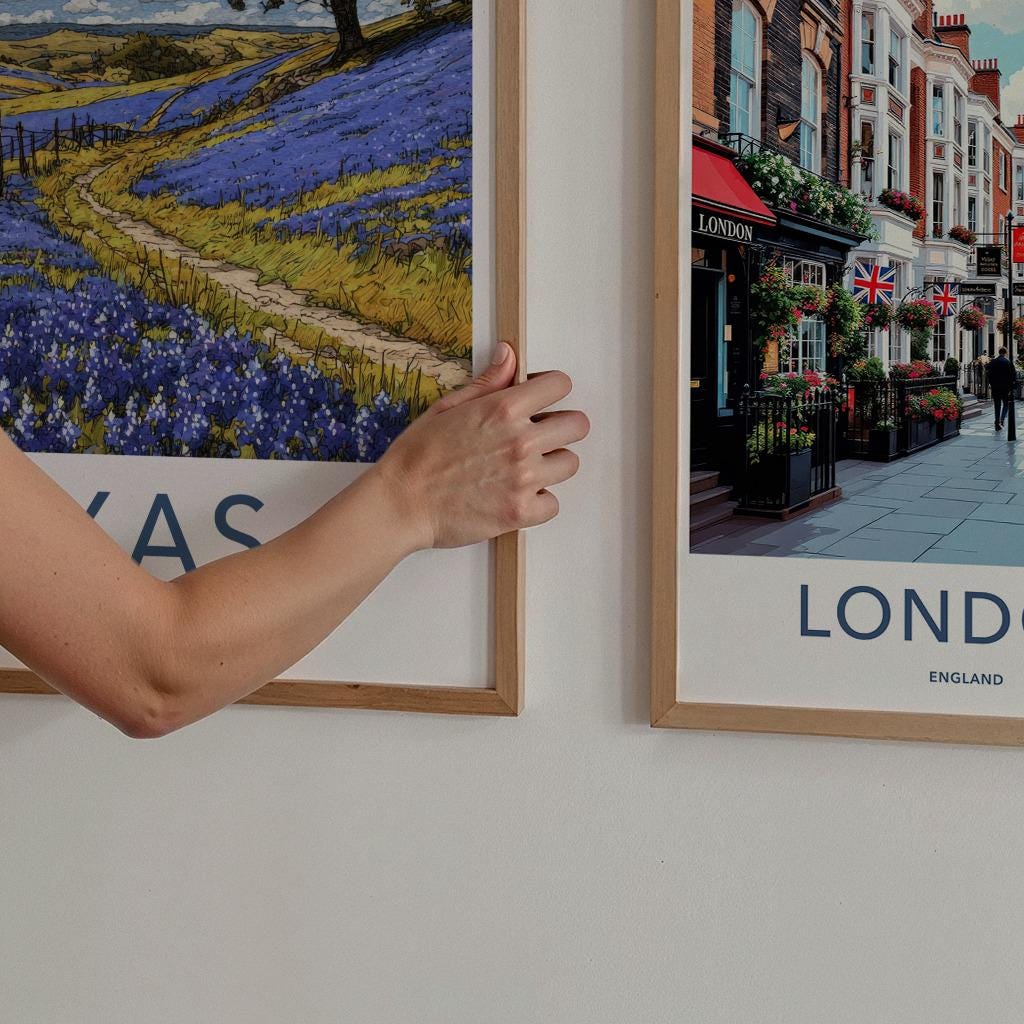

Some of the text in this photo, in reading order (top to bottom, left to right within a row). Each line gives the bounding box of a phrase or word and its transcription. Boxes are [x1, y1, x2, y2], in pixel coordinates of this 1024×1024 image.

[698, 213, 753, 242] LONDON
[800, 584, 1024, 645] LOND
[929, 670, 1004, 686] ENGLAND
